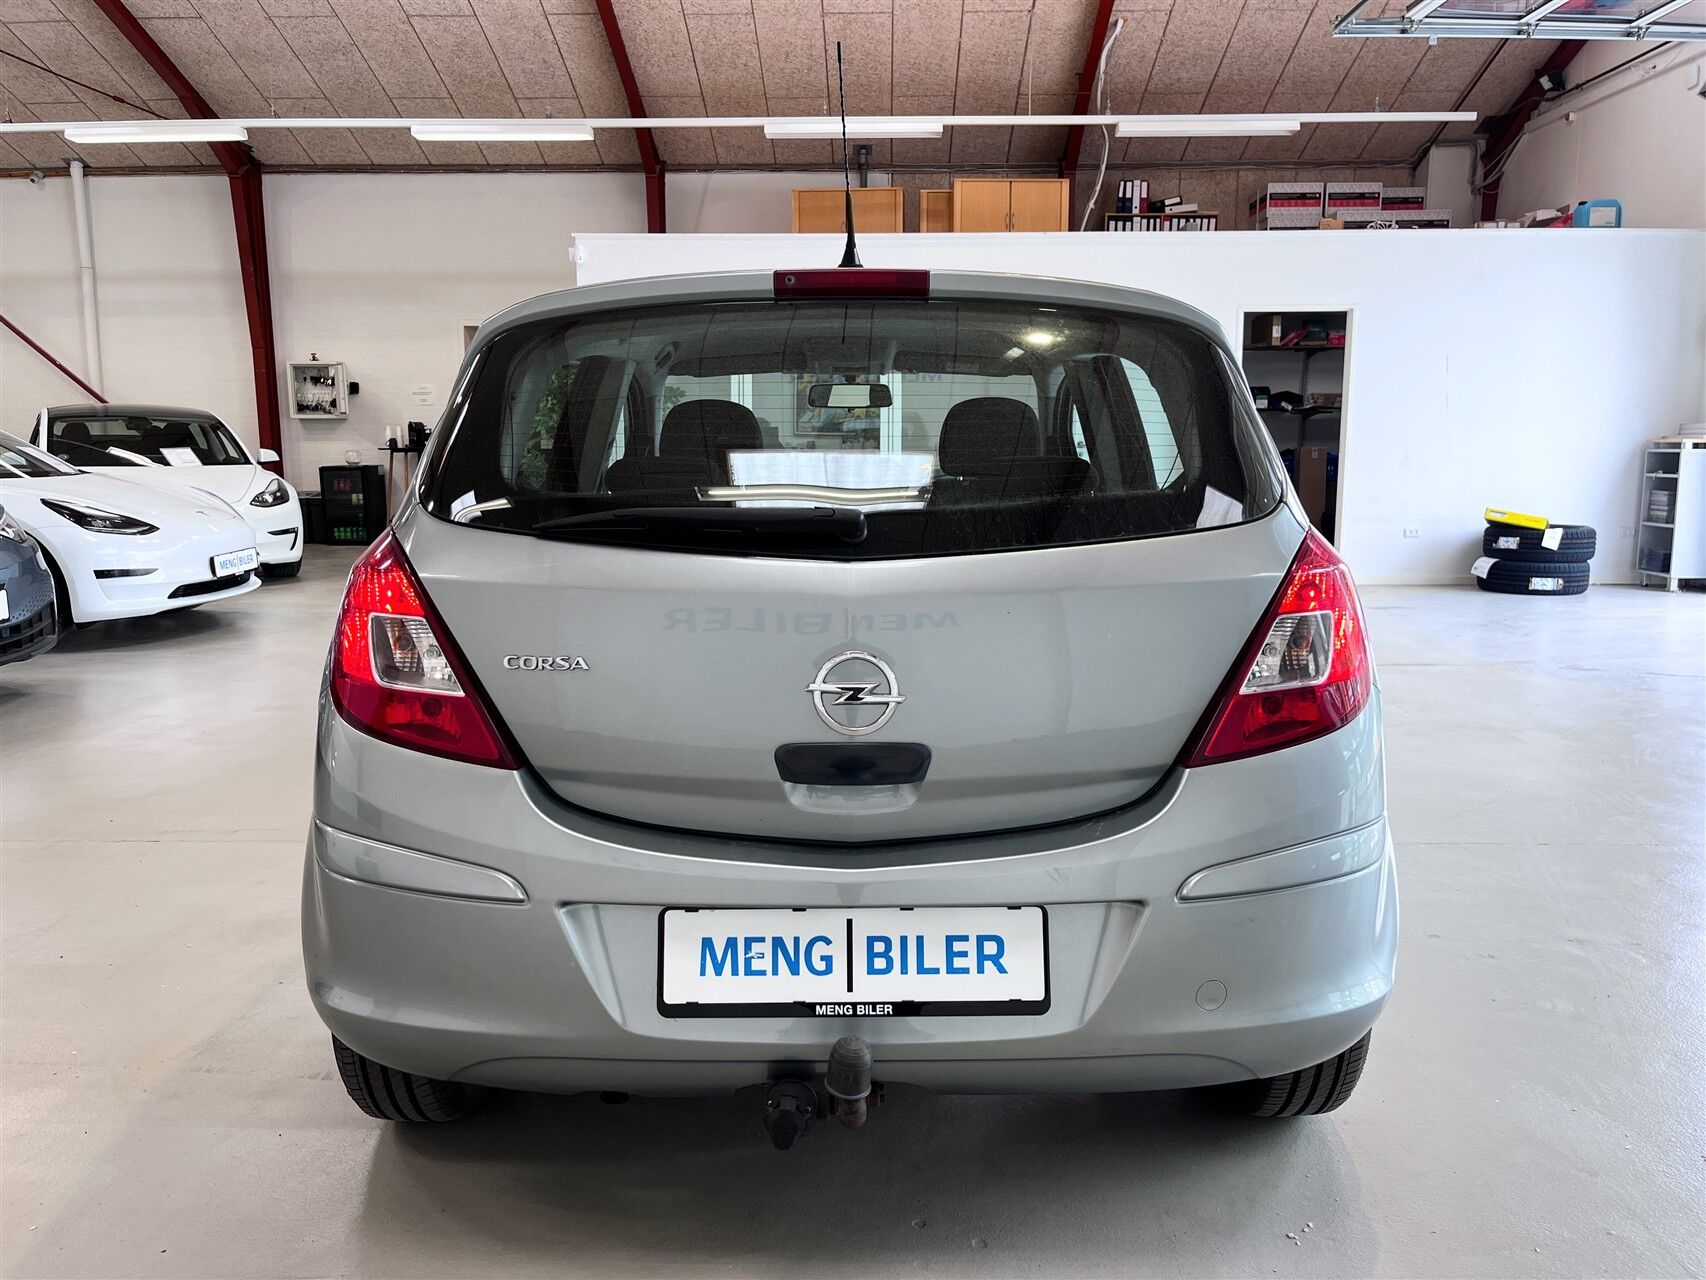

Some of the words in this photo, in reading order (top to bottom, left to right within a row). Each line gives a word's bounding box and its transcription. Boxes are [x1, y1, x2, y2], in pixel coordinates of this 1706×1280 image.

[219, 558, 237, 569] MENG
[239, 554, 254, 566] BILER
[503, 655, 590, 671] CORSA
[699, 935, 834, 977] MENG
[866, 934, 1009, 976] BILER
[815, 1004, 853, 1016] MENG
[856, 1004, 893, 1015] BILER
